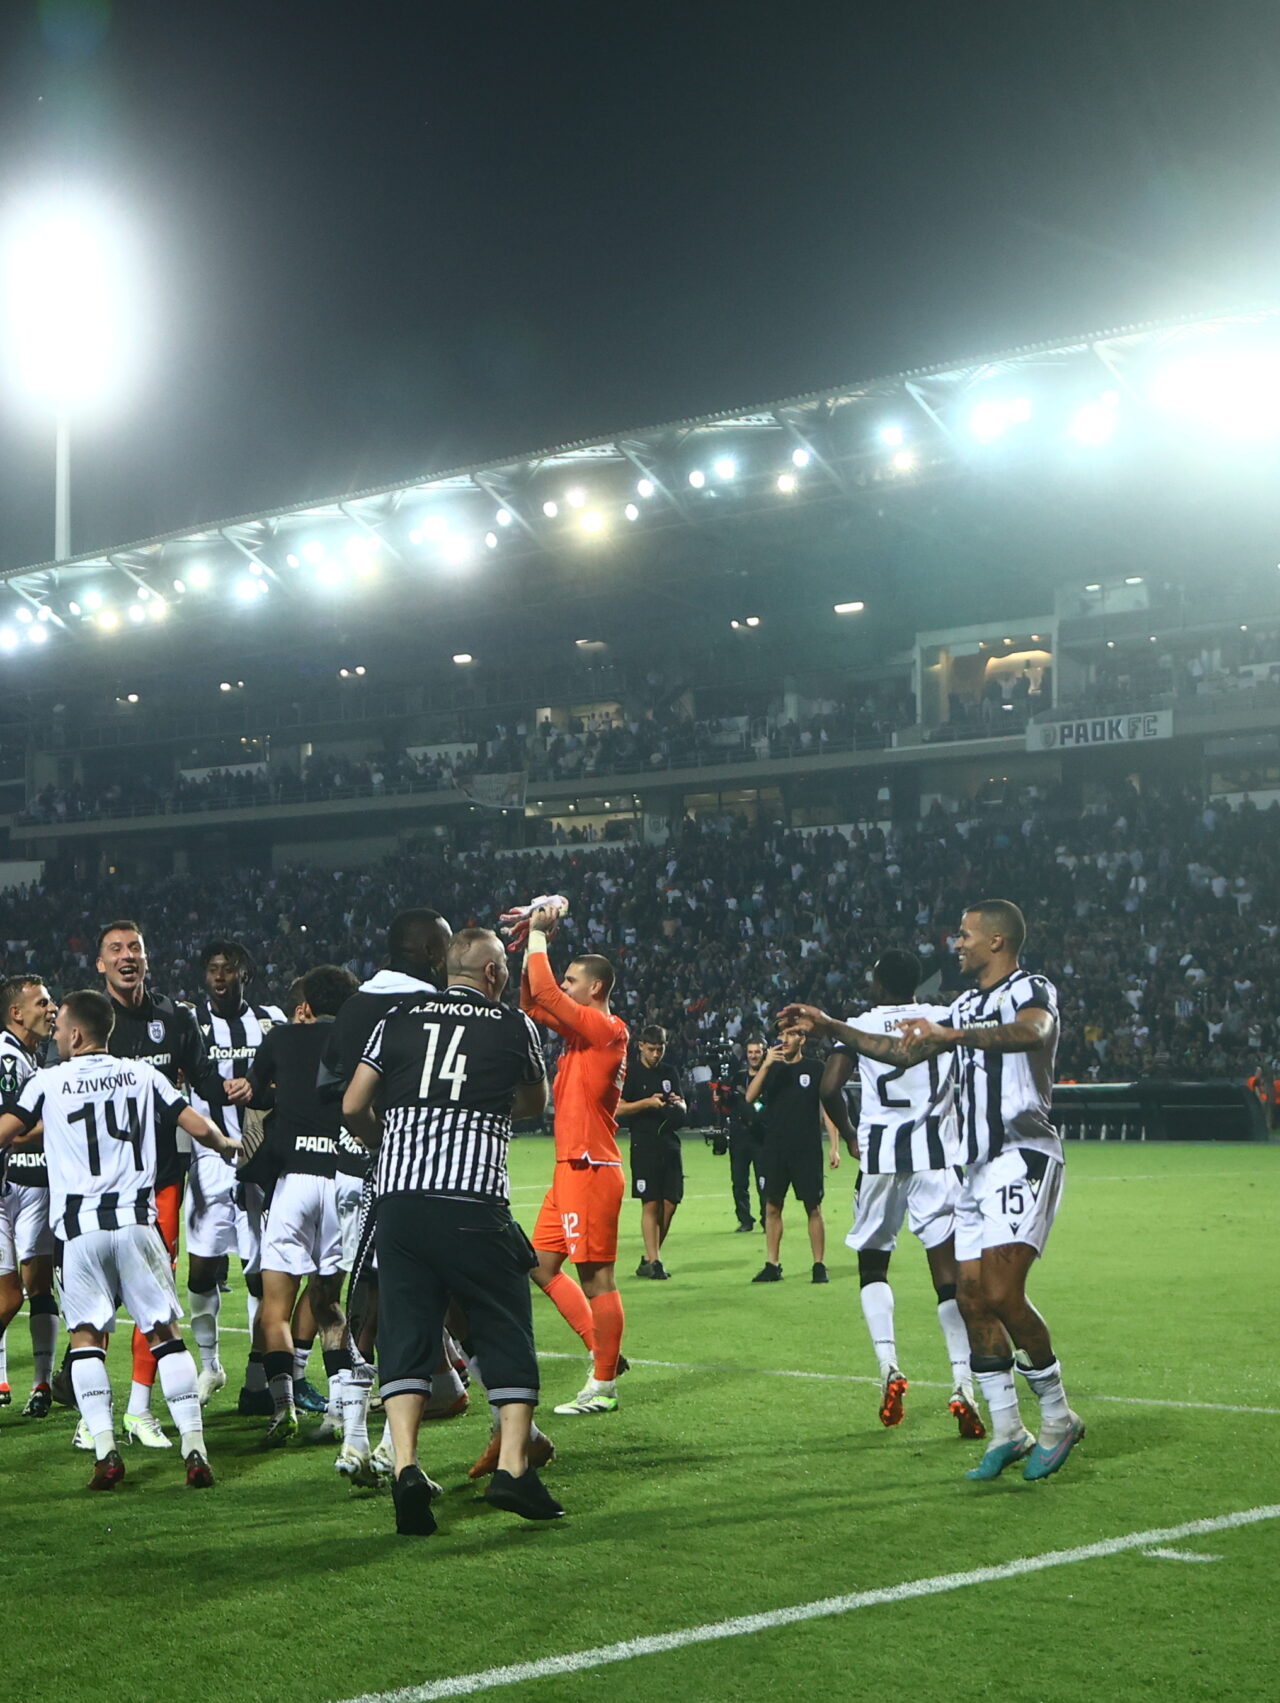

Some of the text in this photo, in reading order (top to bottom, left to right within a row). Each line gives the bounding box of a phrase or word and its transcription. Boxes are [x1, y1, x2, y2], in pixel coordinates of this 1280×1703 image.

[1060, 715, 1158, 745] PAOK FC
[208, 1045, 257, 1059] Stoixim
[418, 1022, 468, 1101] 14
[67, 1097, 144, 1176] 14
[295, 1135, 339, 1156] PAOK
[8, 1152, 47, 1168] PAOK
[995, 1184, 1025, 1215] 15
[82, 1388, 104, 1400] PAOK
